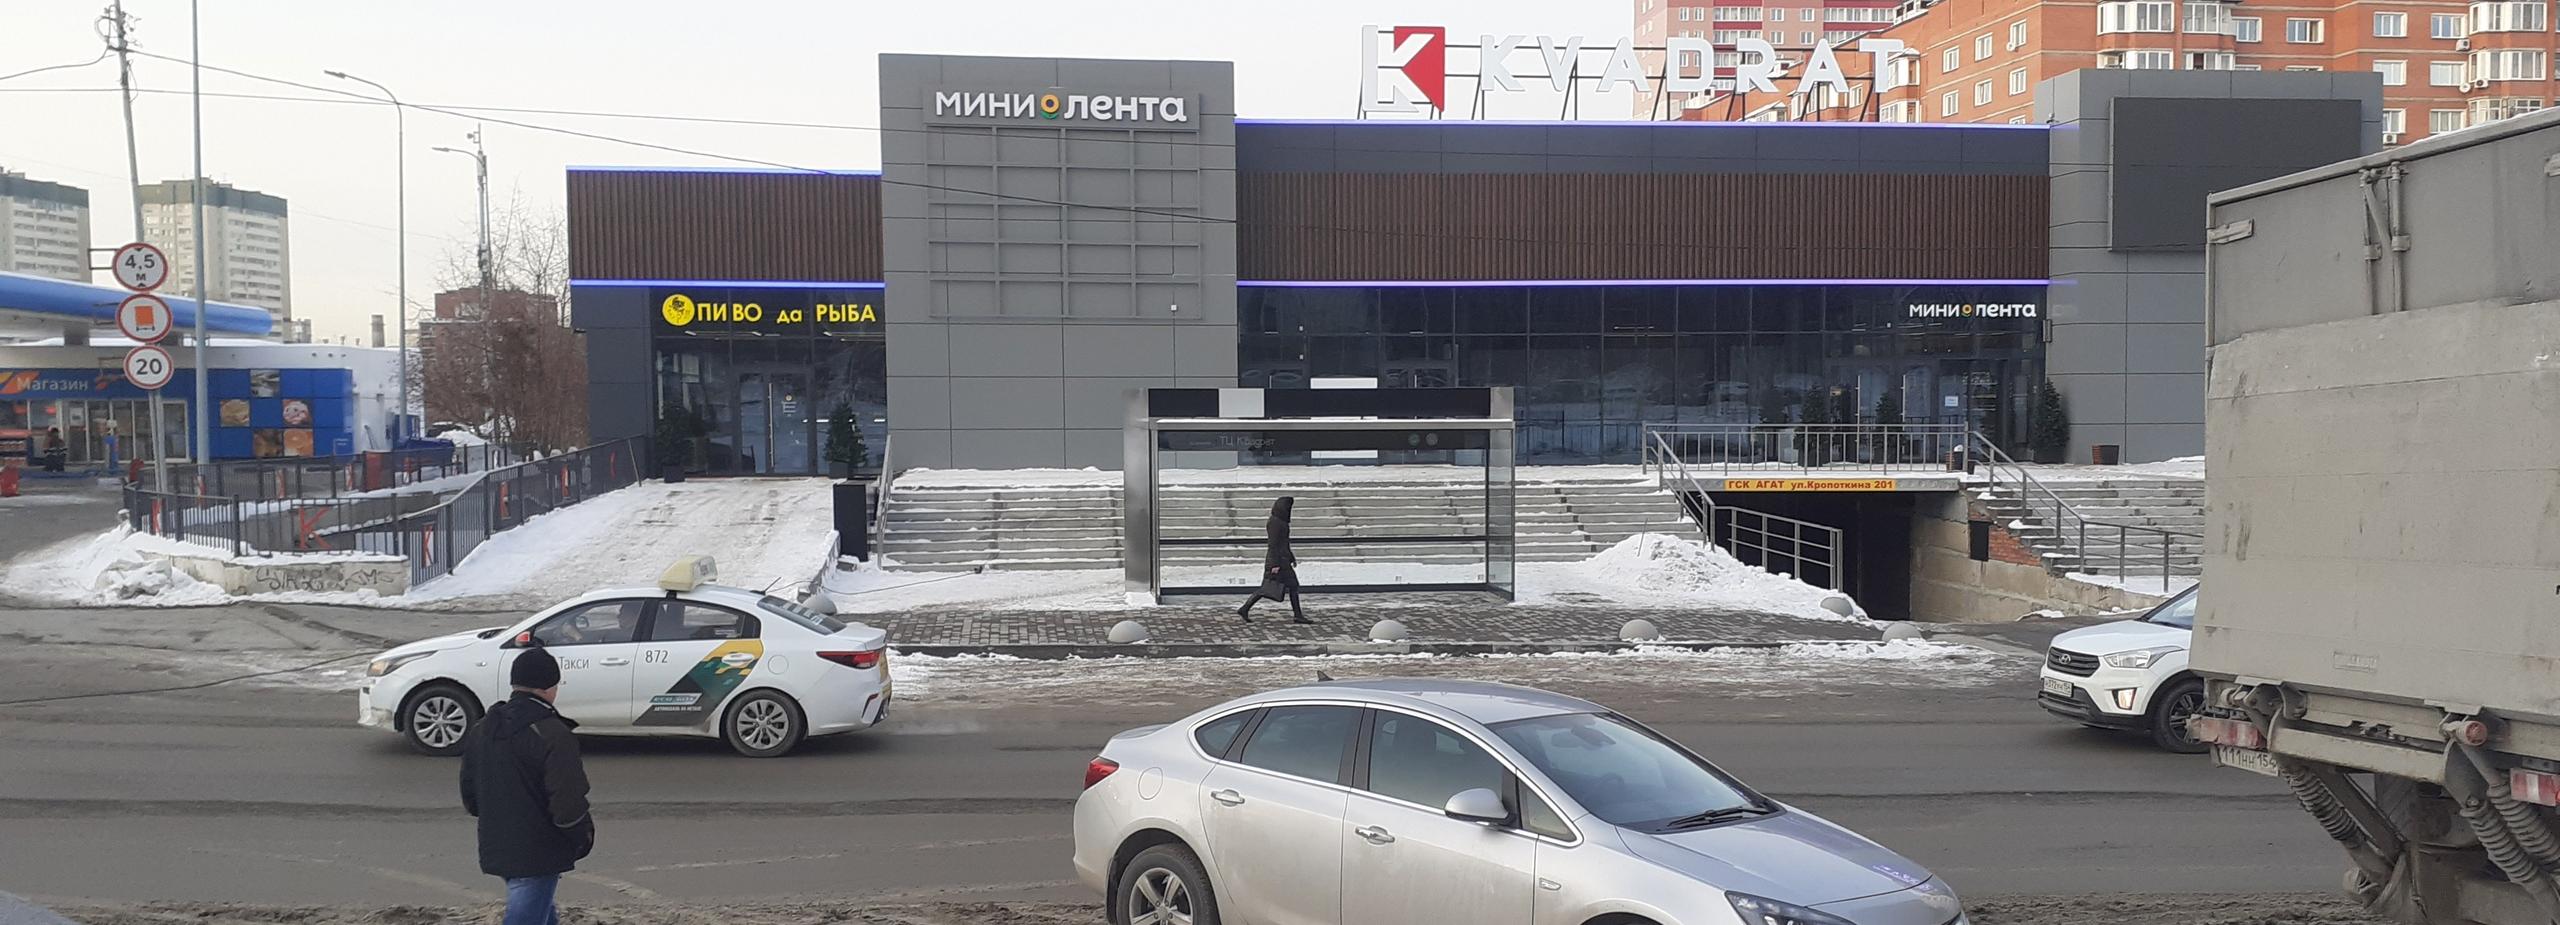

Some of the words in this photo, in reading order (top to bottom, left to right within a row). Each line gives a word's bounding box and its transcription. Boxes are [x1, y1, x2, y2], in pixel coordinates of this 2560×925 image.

[1480, 34, 1905, 93] KVADRAT
[1064, 94, 1188, 122] лента
[125, 254, 156, 270] 4,5
[776, 309, 802, 323] да
[816, 304, 876, 322] РЫБА
[1975, 303, 2037, 317] лента
[135, 358, 163, 375] 20
[16, 377, 89, 391] Магазин
[1728, 480, 1750, 489] ГСК
[1756, 480, 1785, 489] АГАТ
[1874, 480, 1893, 489] 201
[559, 656, 590, 669] Такси
[645, 650, 669, 663] 872
